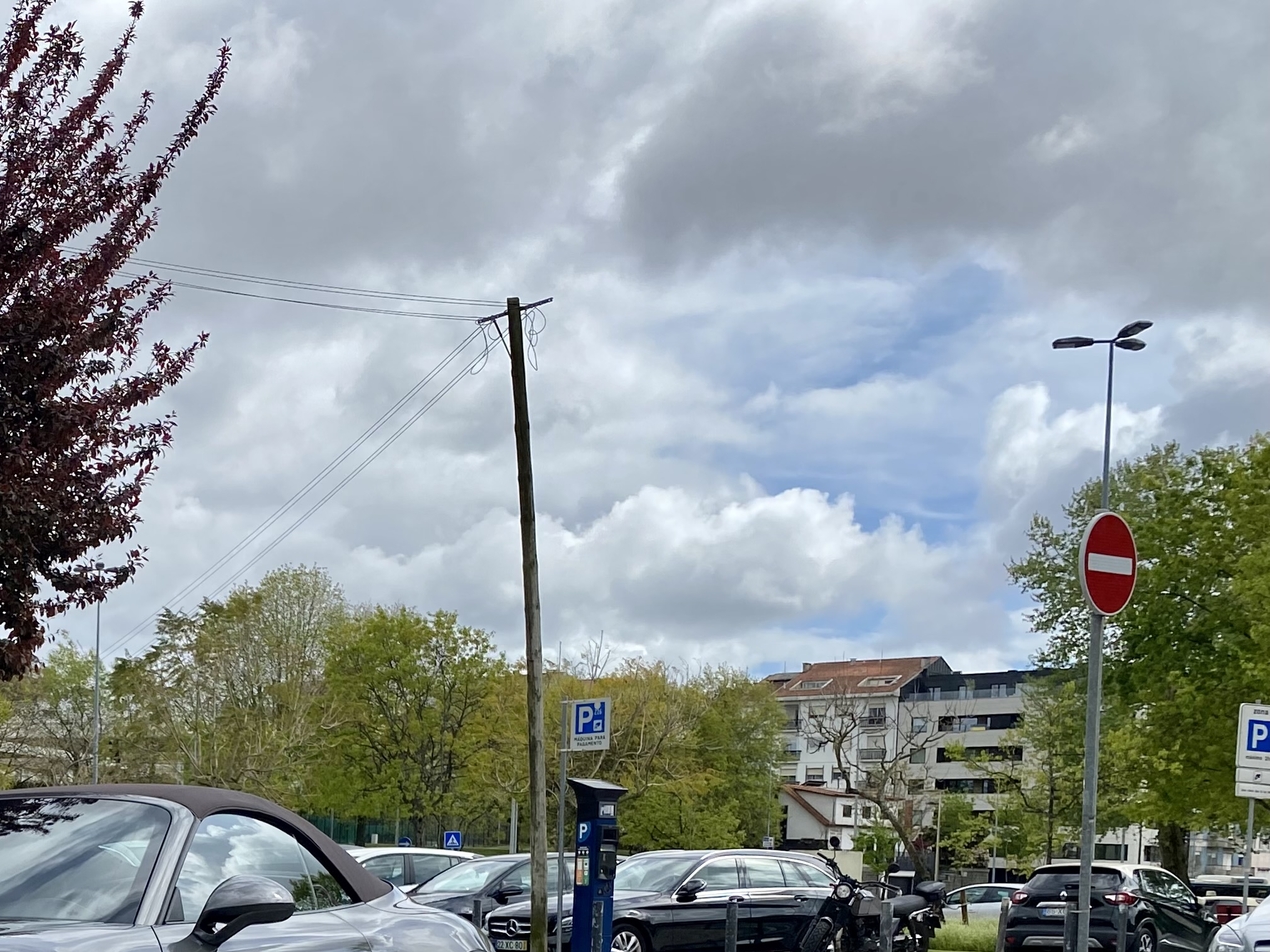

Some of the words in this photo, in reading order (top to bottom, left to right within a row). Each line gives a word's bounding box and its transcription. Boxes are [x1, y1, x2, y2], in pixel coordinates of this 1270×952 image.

[578, 706, 593, 732] P
[1251, 723, 1268, 748] P
[579, 823, 588, 839] P
